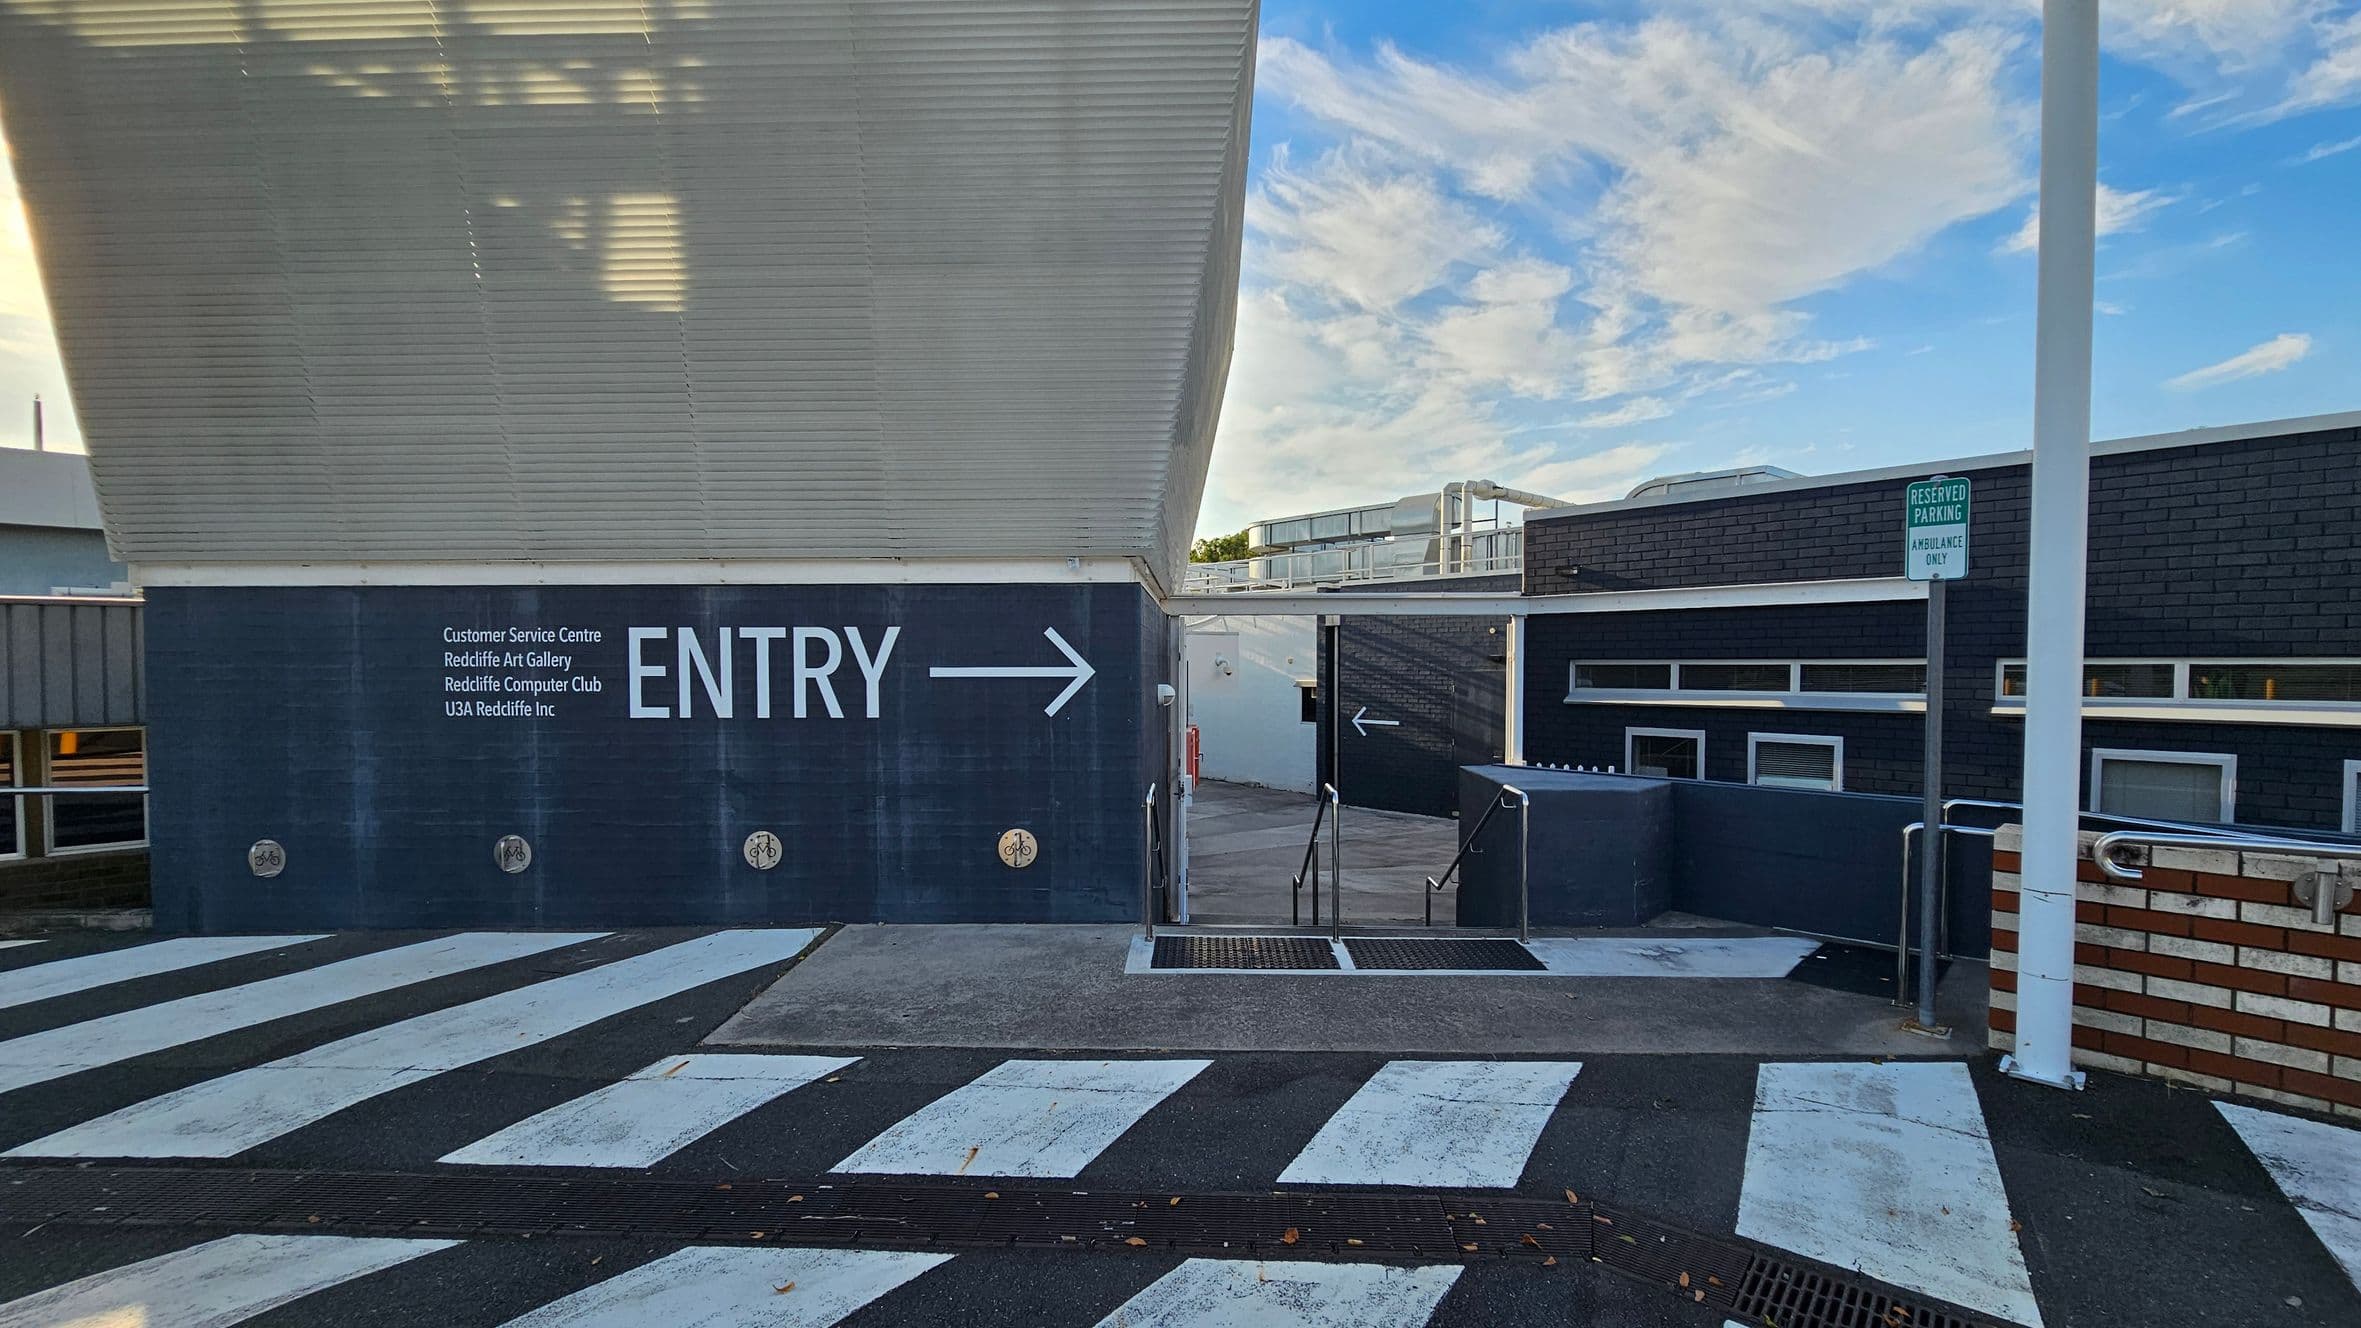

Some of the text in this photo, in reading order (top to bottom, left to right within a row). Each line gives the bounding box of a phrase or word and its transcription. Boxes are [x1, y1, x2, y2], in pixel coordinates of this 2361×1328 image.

[1911, 484, 1966, 505] RESERVED
[1914, 504, 1962, 523] PARKING
[1911, 536, 1963, 551] AMBULANCE
[1926, 552, 1948, 565] ONLY
[443, 626, 602, 643] Customer Service Centre
[444, 651, 572, 672] Redcliffe Art Gallery
[628, 626, 902, 719] ENTRY
[445, 675, 602, 696] Redcliffe Computer Club
[445, 700, 556, 717] U3A Redcliffe Inc
